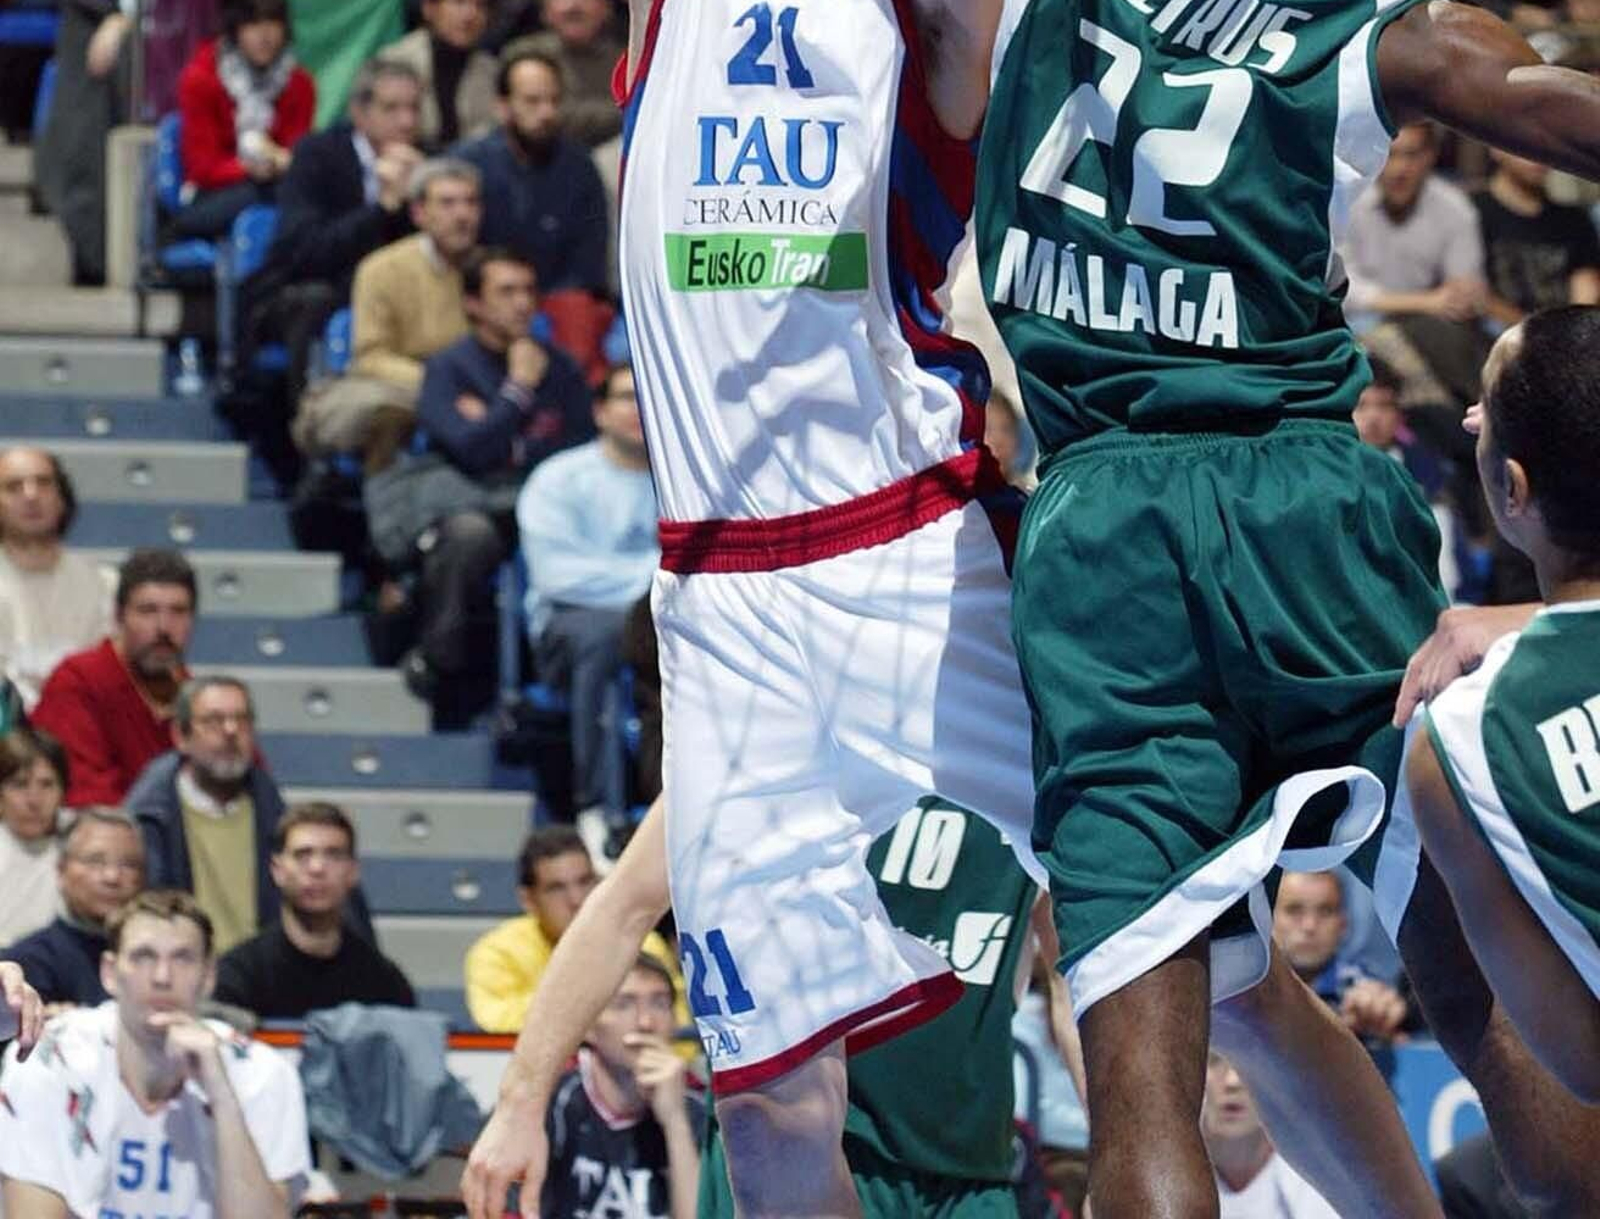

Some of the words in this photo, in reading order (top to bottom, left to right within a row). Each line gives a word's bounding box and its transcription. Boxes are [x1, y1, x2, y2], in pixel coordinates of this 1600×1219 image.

[727, 1, 815, 88] 21
[1019, 18, 1253, 236] 22
[683, 190, 841, 226] CERÁMICA
[993, 227, 1240, 348] MÁLAGA
[880, 806, 967, 890] 10
[680, 929, 756, 1016] 21
[118, 1140, 172, 1192] 51
